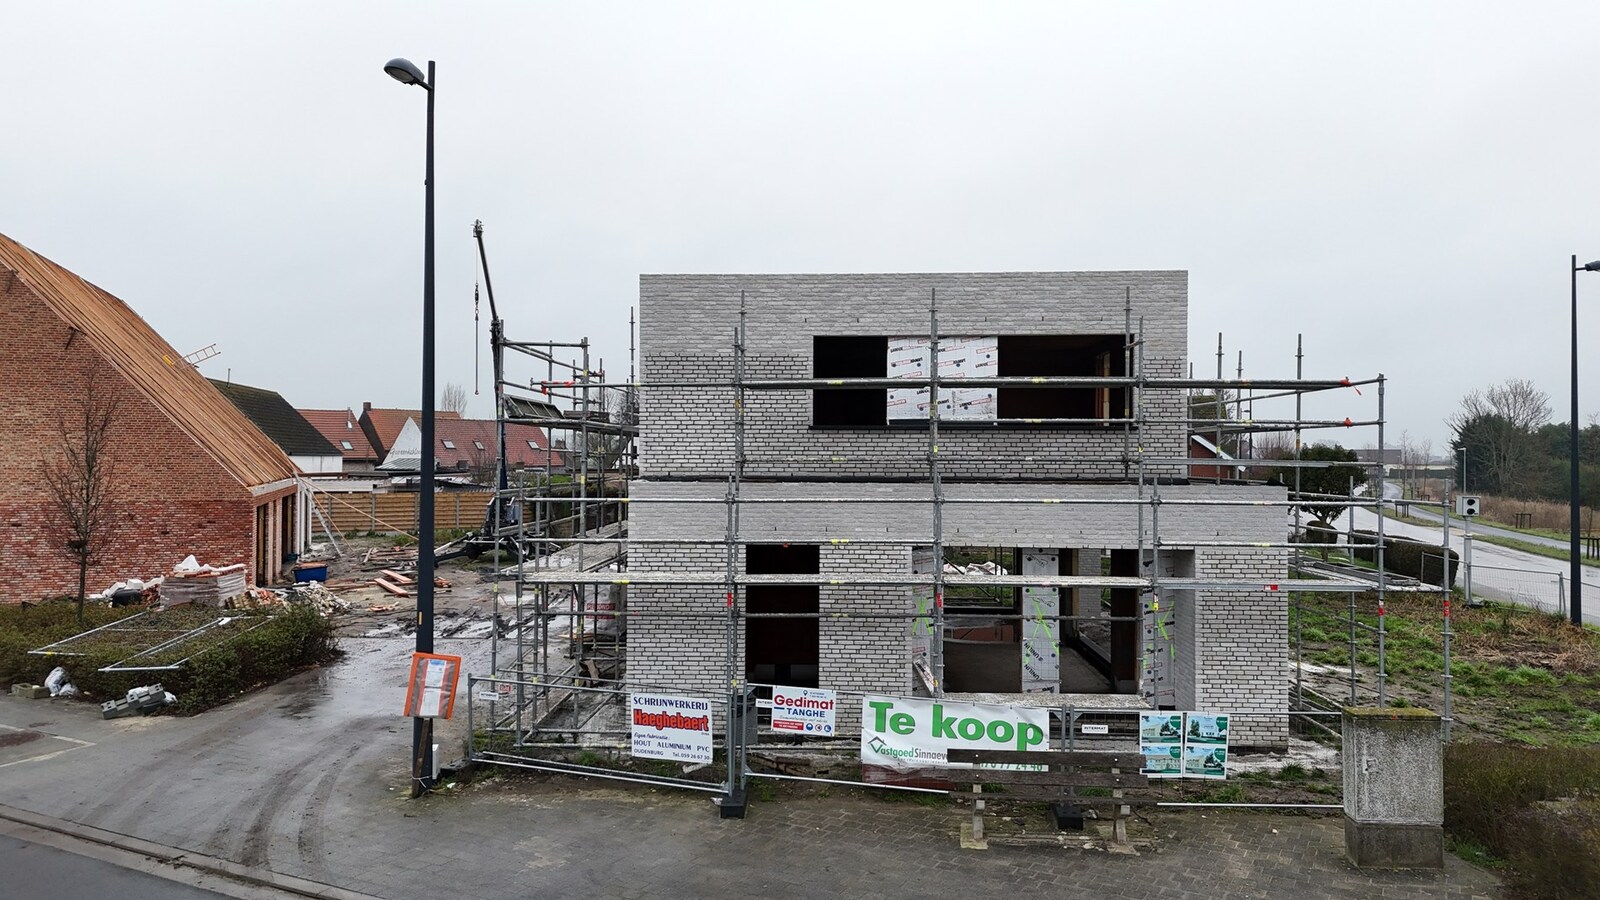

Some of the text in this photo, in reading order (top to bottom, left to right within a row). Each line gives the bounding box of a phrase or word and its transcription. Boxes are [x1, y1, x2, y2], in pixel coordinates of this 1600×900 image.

[633, 696, 708, 711] SCHRIJNWERKERIJ
[774, 694, 834, 710] Gedimat
[633, 708, 709, 732] Haeghebaert
[786, 707, 826, 718] TANGHE
[869, 701, 1044, 750] Te koop
[633, 748, 664, 756] OUDENBURG
[656, 741, 692, 751] ALUMINIUM
[696, 745, 710, 753] PVC
